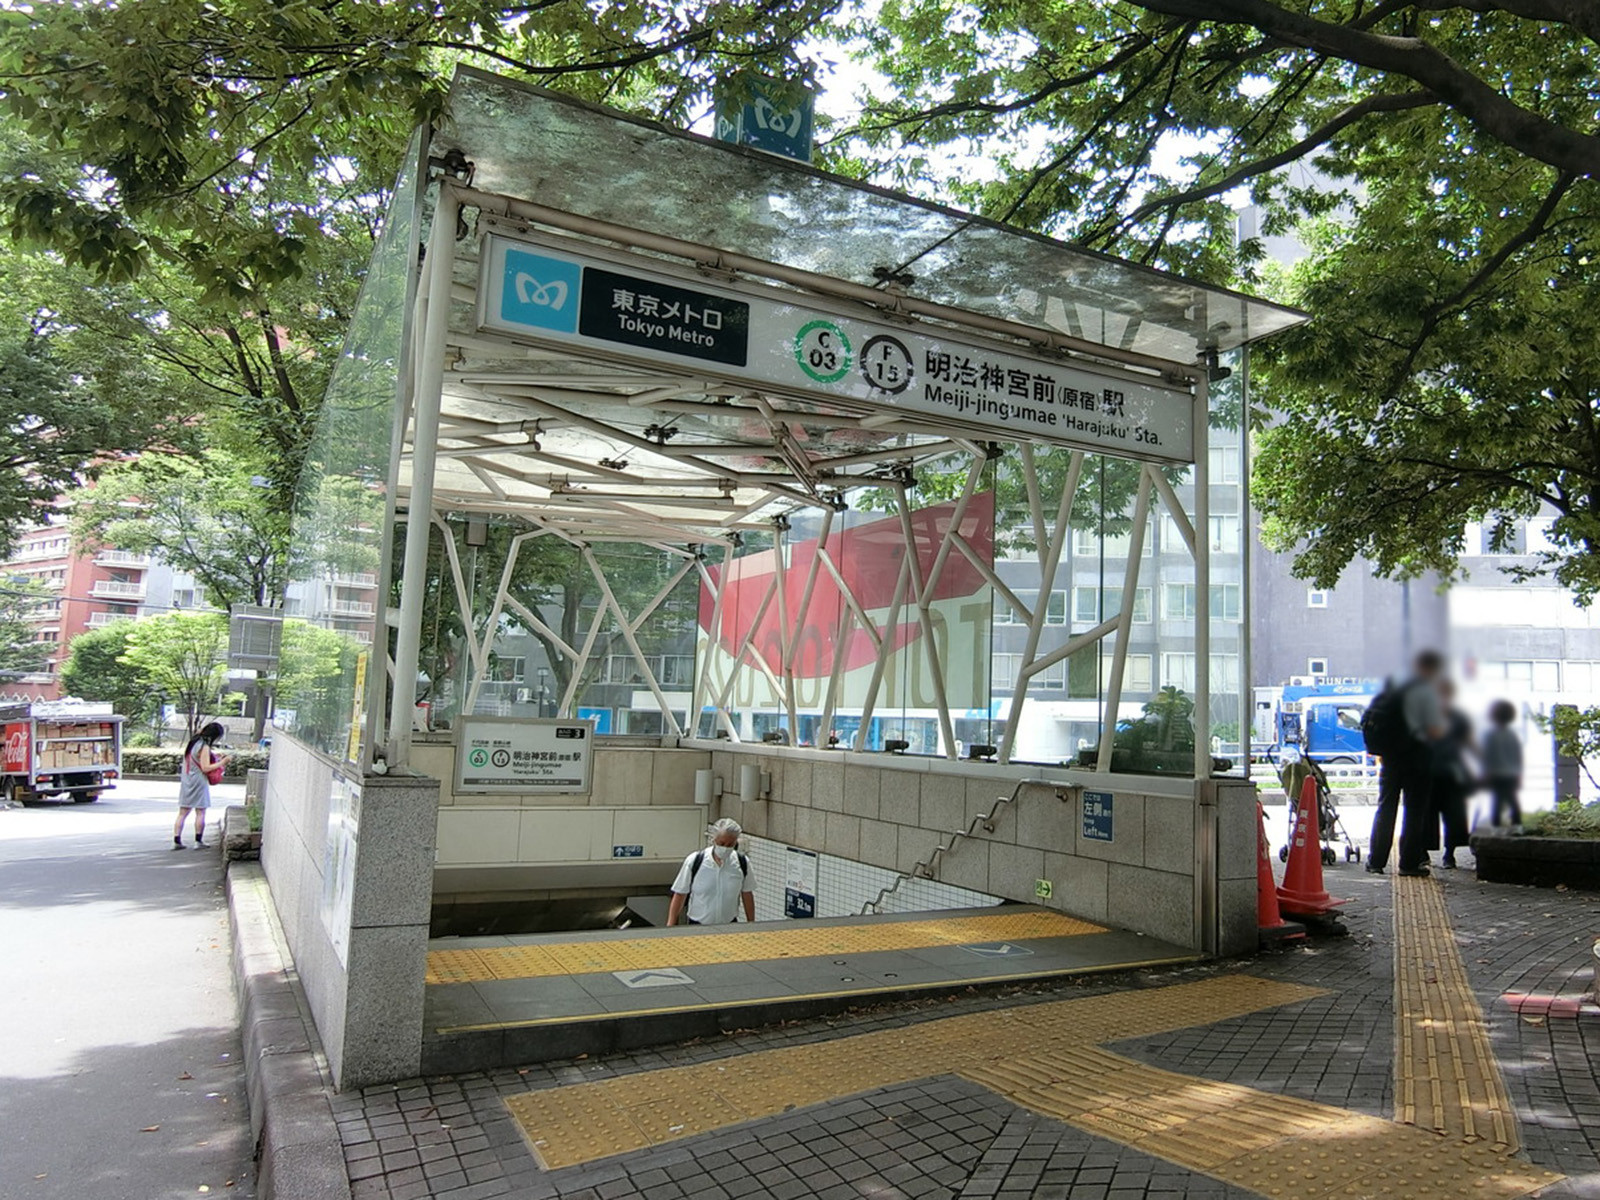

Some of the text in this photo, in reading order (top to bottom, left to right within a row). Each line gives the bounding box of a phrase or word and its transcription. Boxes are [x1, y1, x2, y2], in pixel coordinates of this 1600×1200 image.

[611, 288, 722, 330] 東京メトロ
[617, 313, 715, 347] Tokyo Metro
[818, 332, 830, 348] C
[810, 349, 836, 370] 03
[883, 345, 892, 361] F
[877, 363, 898, 382] 15
[925, 384, 1056, 425] Meiji-jingumae
[1135, 426, 1162, 446] Sta.
